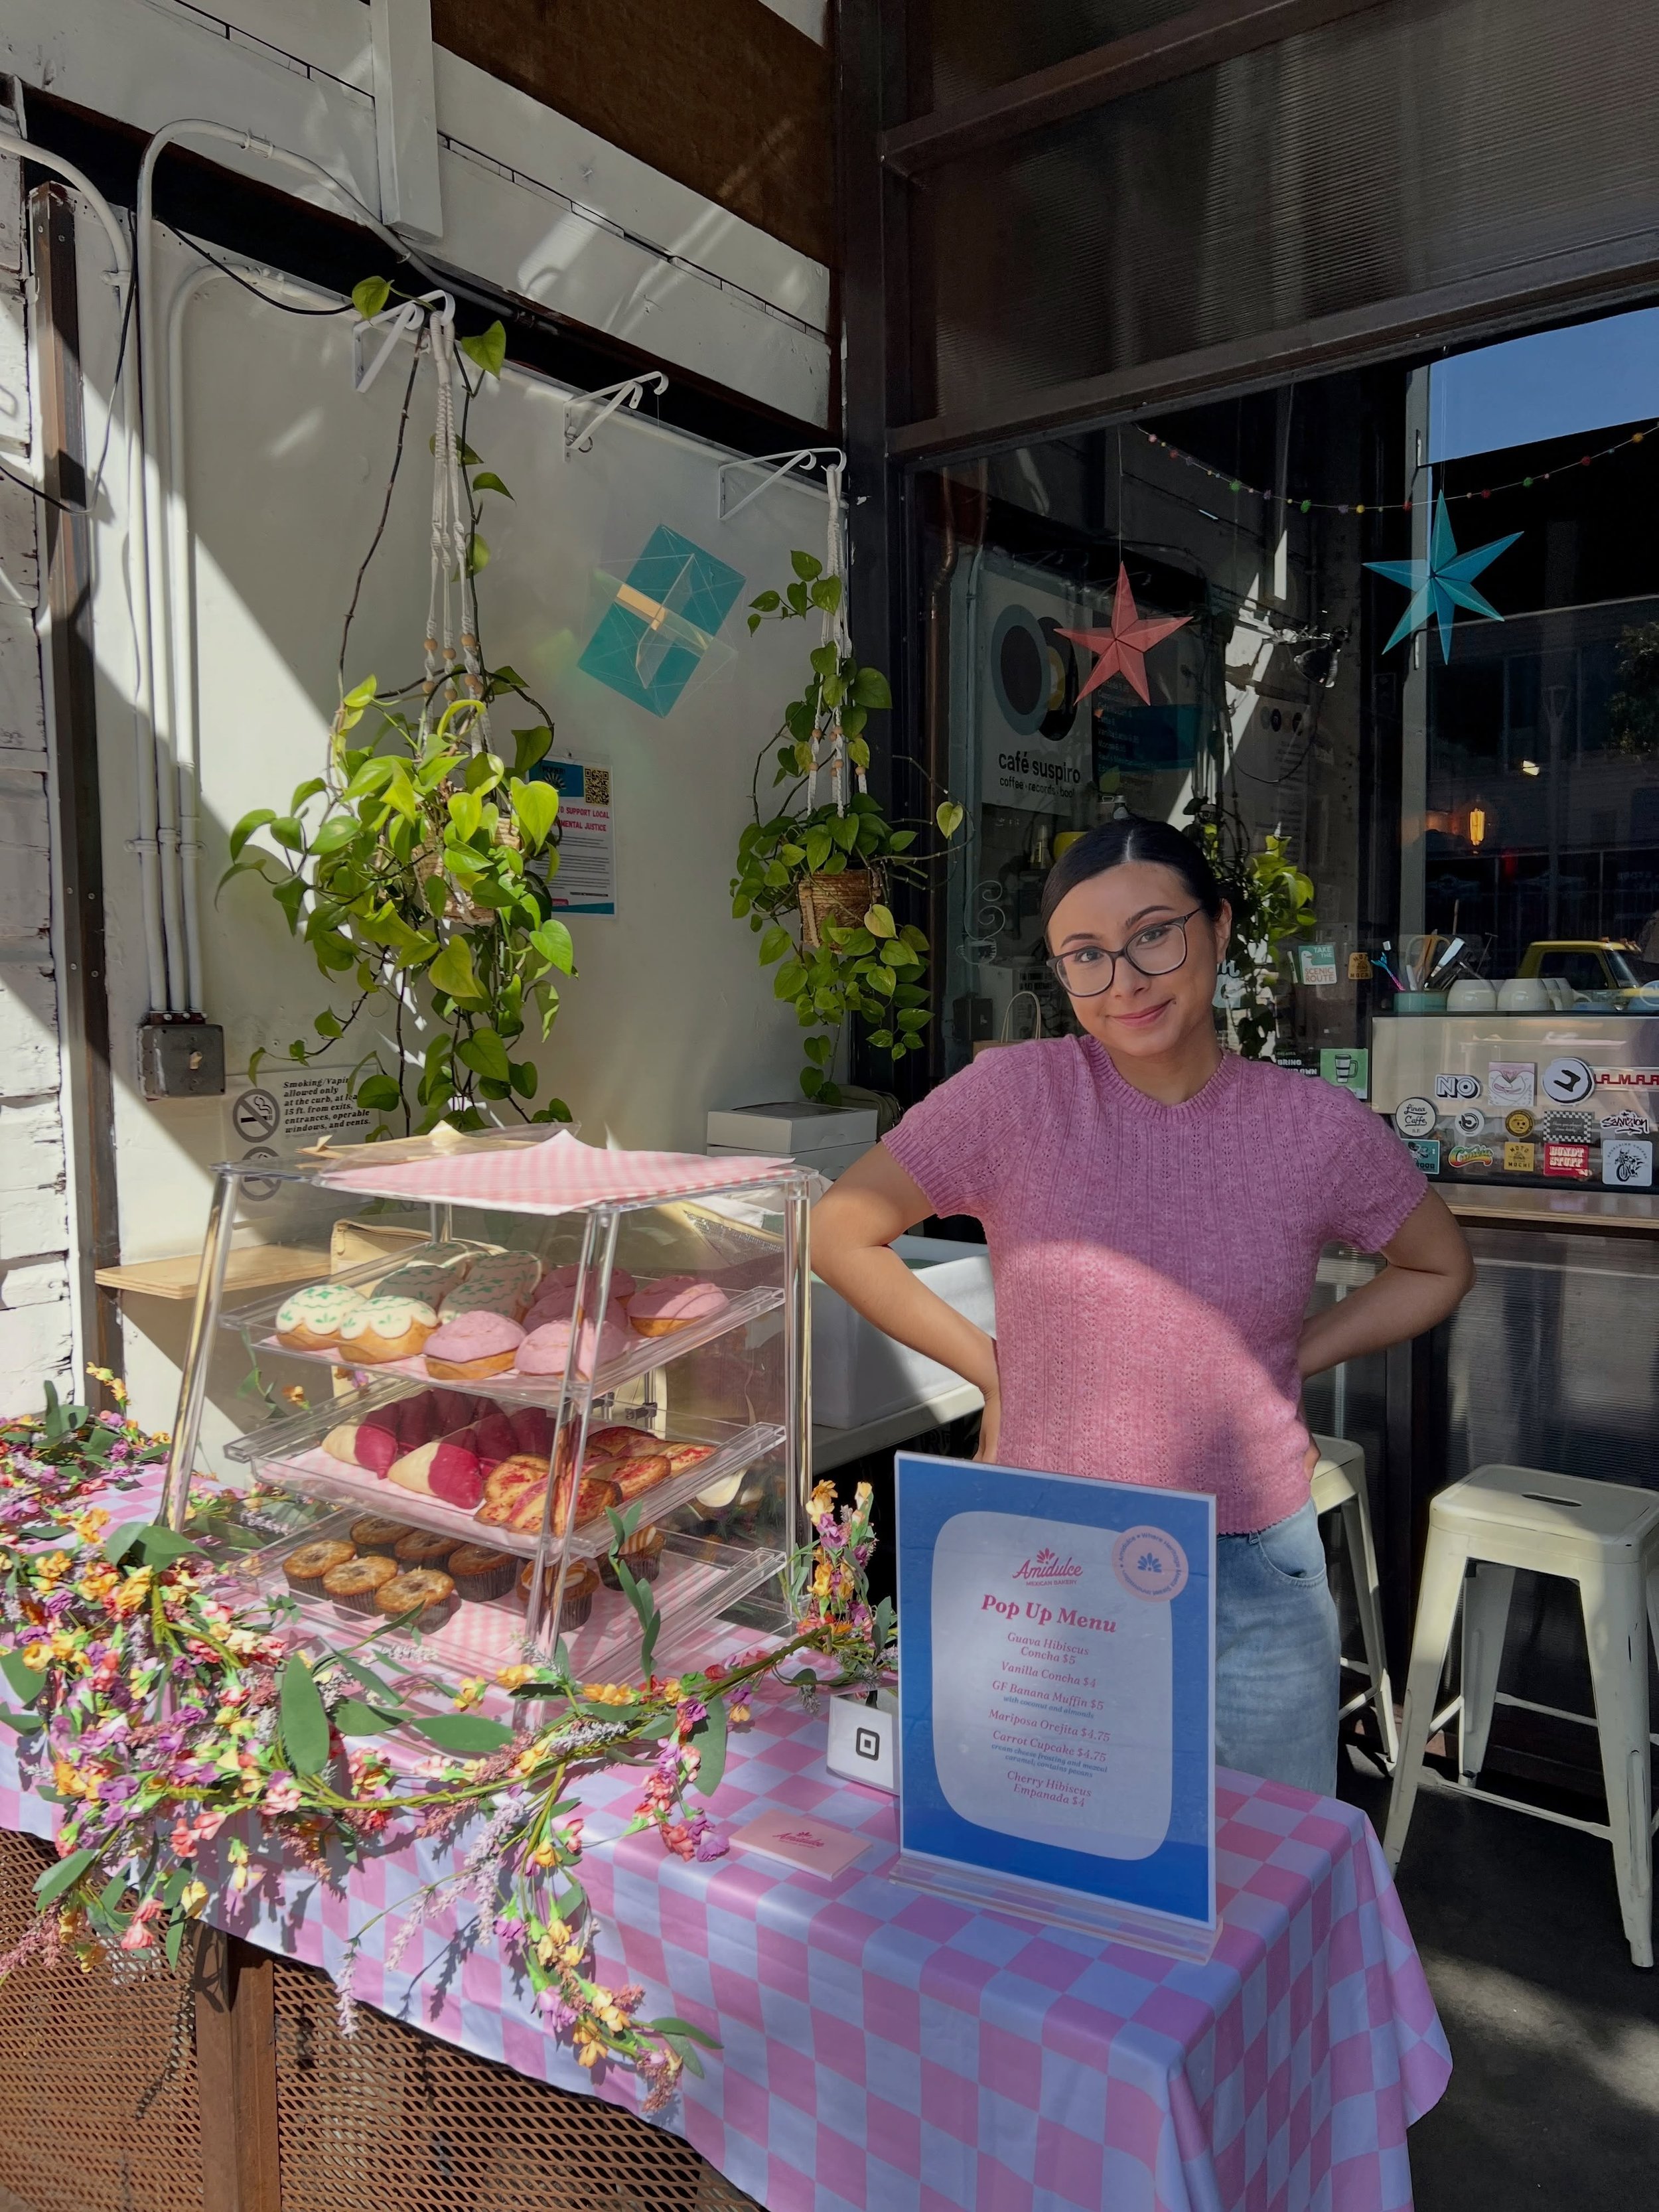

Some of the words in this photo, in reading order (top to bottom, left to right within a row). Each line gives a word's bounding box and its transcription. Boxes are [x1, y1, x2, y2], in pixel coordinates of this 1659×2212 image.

[999, 751, 1029, 774] café
[1032, 761, 1080, 785] suspiro
[999, 776, 1023, 790] coffee
[1029, 782, 1056, 795] records
[566, 807, 591, 816] SUPPORT
[593, 810, 610, 818] LOCAL
[1305, 967, 1334, 976] SCENIC
[1305, 975, 1335, 984] ROUTE
[283, 1077, 348, 1088] Smoking/Vapi
[284, 1088, 319, 1098] allowed
[321, 1086, 339, 1095] only
[1437, 1076, 1478, 1098] NO
[311, 1095, 333, 1104] curb,
[1404, 1104, 1427, 1115] Linea
[285, 1116, 331, 1125] entrances,
[333, 1110, 370, 1120] operable
[346, 1118, 372, 1126] vents.
[1013, 1556, 1083, 1580] Amidulce
[981, 1594, 1019, 1620] Pop
[1026, 1602, 1052, 1626] Up
[1056, 1607, 1118, 1633] Menu
[1007, 1632, 1041, 1647] Guava
[1044, 1639, 1090, 1655] Hibiscus
[1021, 1647, 1060, 1662] Concha
[1062, 1654, 1078, 1664] $5
[1002, 1661, 1039, 1677] Vanilla
[1041, 1670, 1080, 1685] Concha
[1083, 1678, 1098, 1688] $4
[992, 1680, 1008, 1690] GF
[1009, 1683, 1050, 1700] Banana
[1052, 1692, 1087, 1708] Muffin
[1090, 1698, 1105, 1711] $5
[1003, 1696, 1019, 1705] with
[1020, 1700, 1047, 1710] coconut
[1048, 1705, 1062, 1714] and
[1063, 1706, 1094, 1719] almonds
[988, 1709, 1037, 1726] Mariposa
[1040, 1720, 1078, 1735] Orejita
[1081, 1728, 1111, 1742] $4.75
[993, 1730, 1027, 1745] Carrot
[1030, 1737, 1074, 1755] Cupcake
[1077, 1748, 1107, 1763] $4.75
[991, 1743, 1013, 1753] cream
[1014, 1749, 1037, 1758] cheese
[1037, 1752, 1066, 1765] frosting
[1082, 1764, 1108, 1773] mezcal
[1037, 1761, 1067, 1772] contains
[1068, 1768, 1093, 1778] pecans
[1007, 1770, 1043, 1788] Cherry
[1045, 1778, 1092, 1797] Hibiscus
[1013, 1783, 1069, 1805] Empanada
[1072, 1796, 1085, 1808] $4
